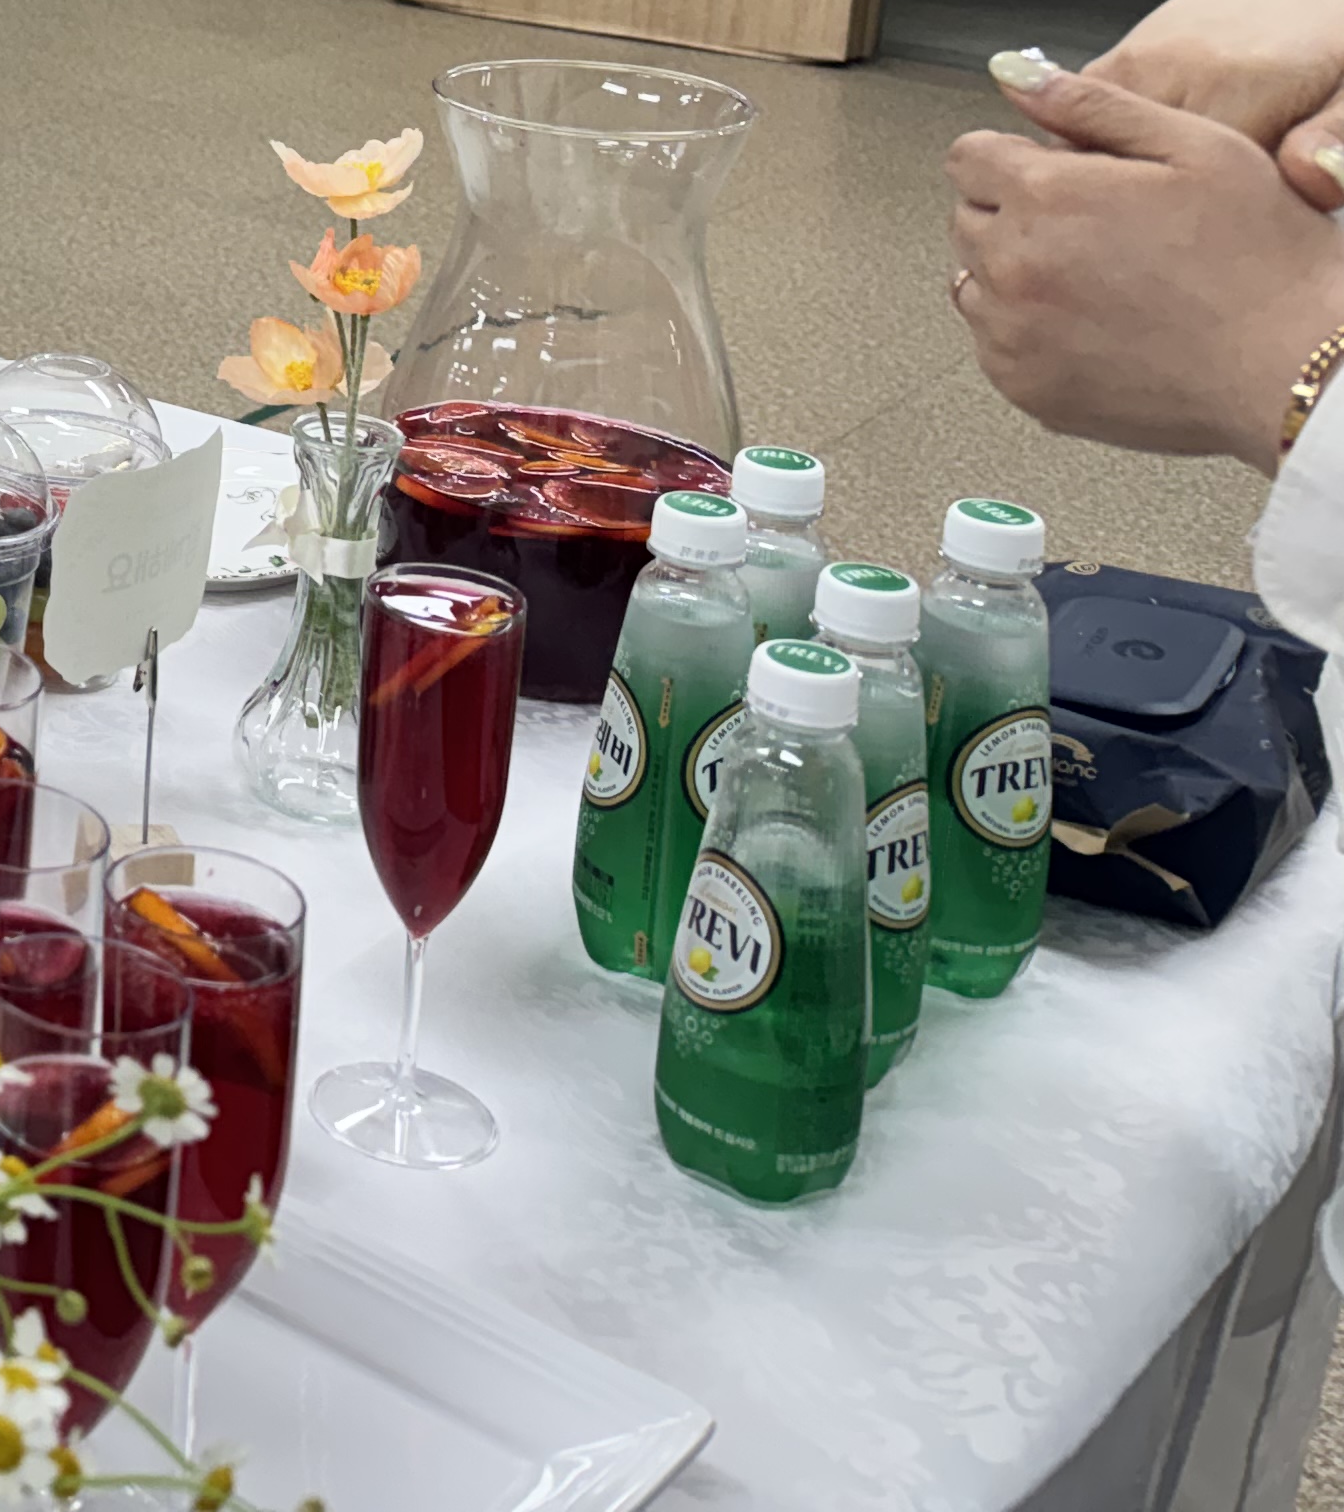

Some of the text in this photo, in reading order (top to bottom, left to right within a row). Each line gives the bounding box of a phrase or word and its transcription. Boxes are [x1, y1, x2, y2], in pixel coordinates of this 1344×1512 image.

[609, 685, 636, 735] PARKLING
[596, 717, 633, 777] 레비
[708, 716, 742, 751] LEMON
[979, 726, 1018, 758] LEMON
[869, 802, 906, 838] LEMON
[715, 865, 763, 927] SPARKLING
